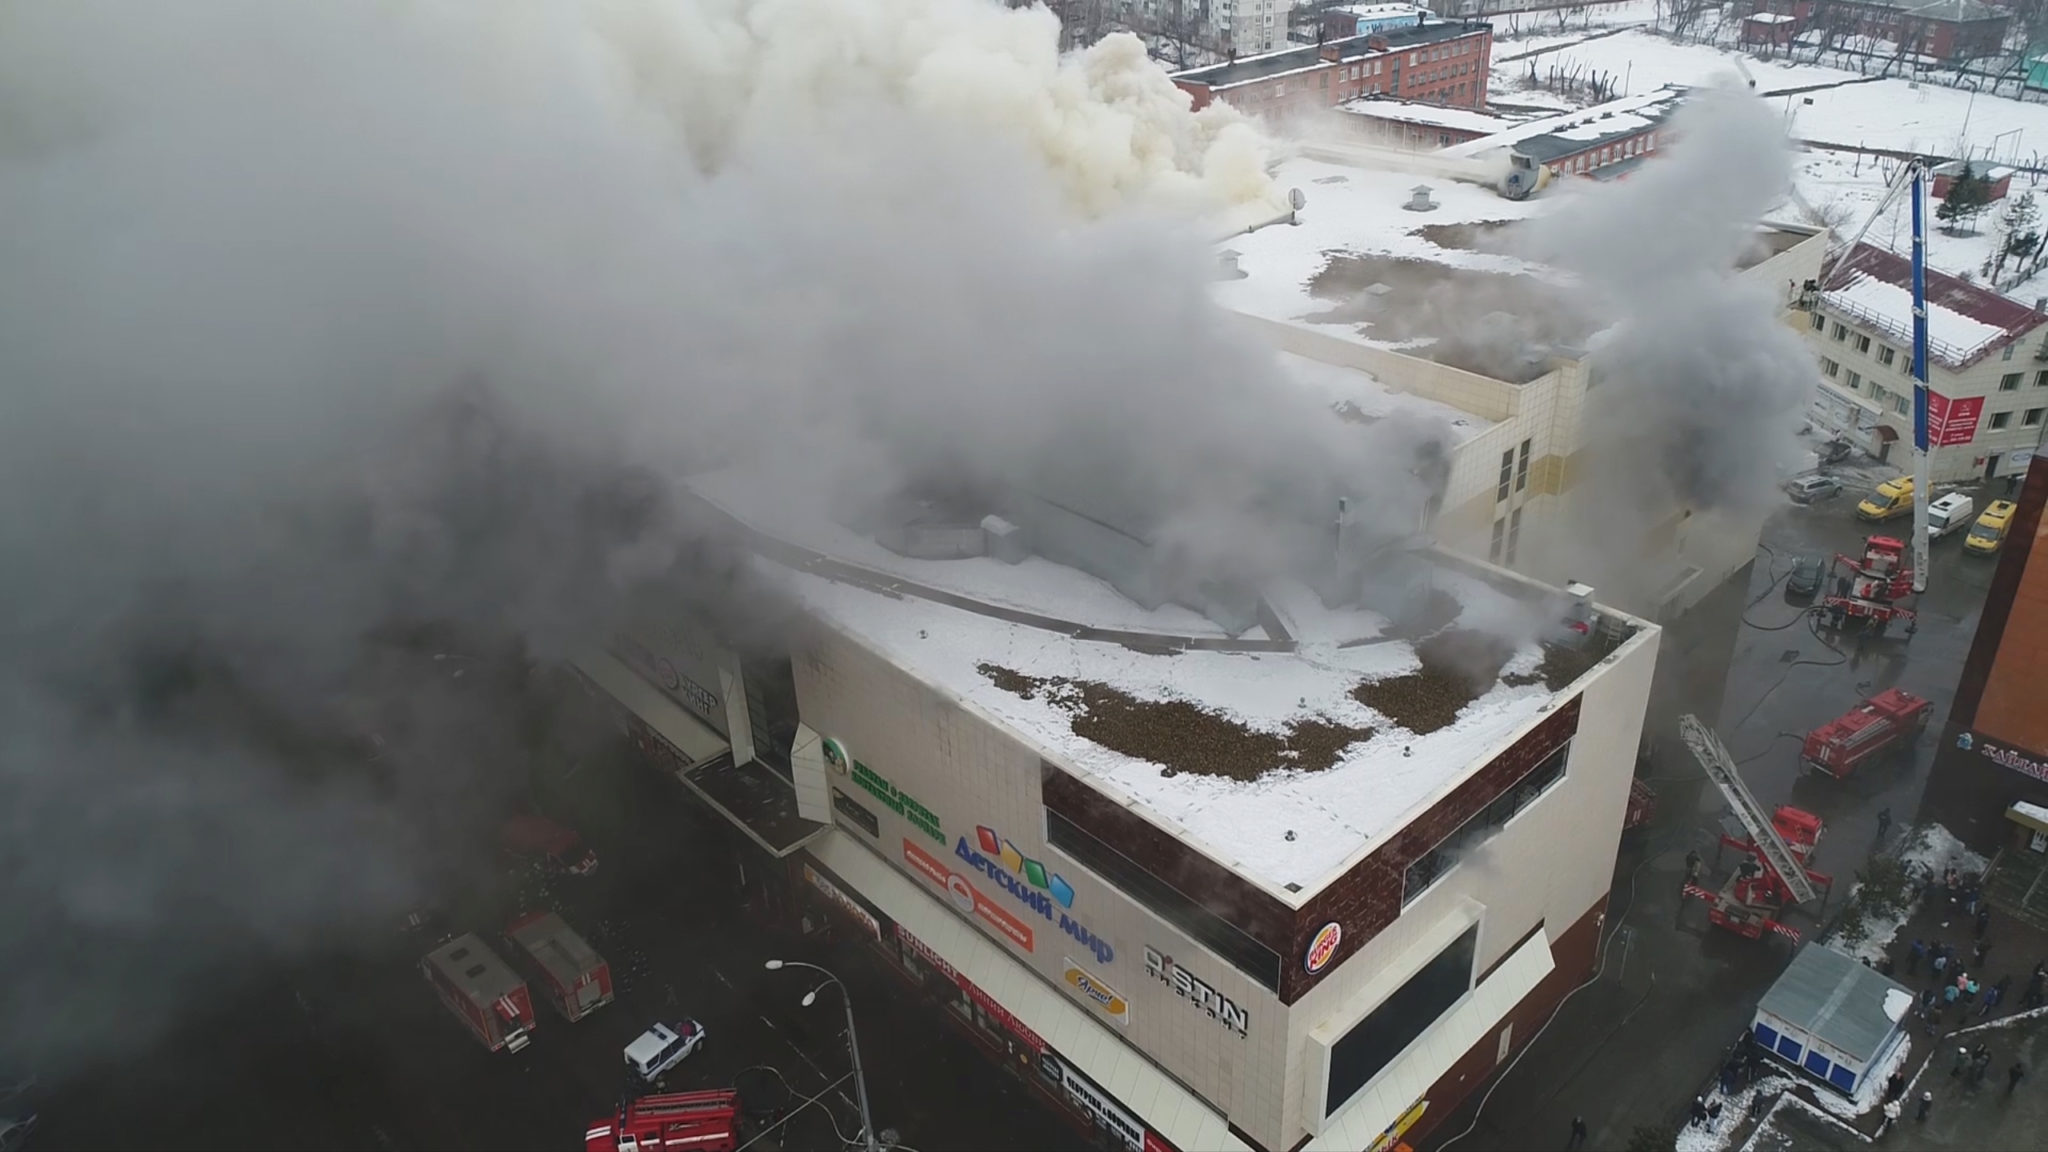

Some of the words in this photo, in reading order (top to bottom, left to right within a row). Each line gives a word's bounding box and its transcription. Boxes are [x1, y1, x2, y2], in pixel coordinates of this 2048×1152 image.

[956, 836, 1052, 920] Детский
[1059, 913, 1114, 964] мир
[897, 924, 957, 978] SUNLIGHT
